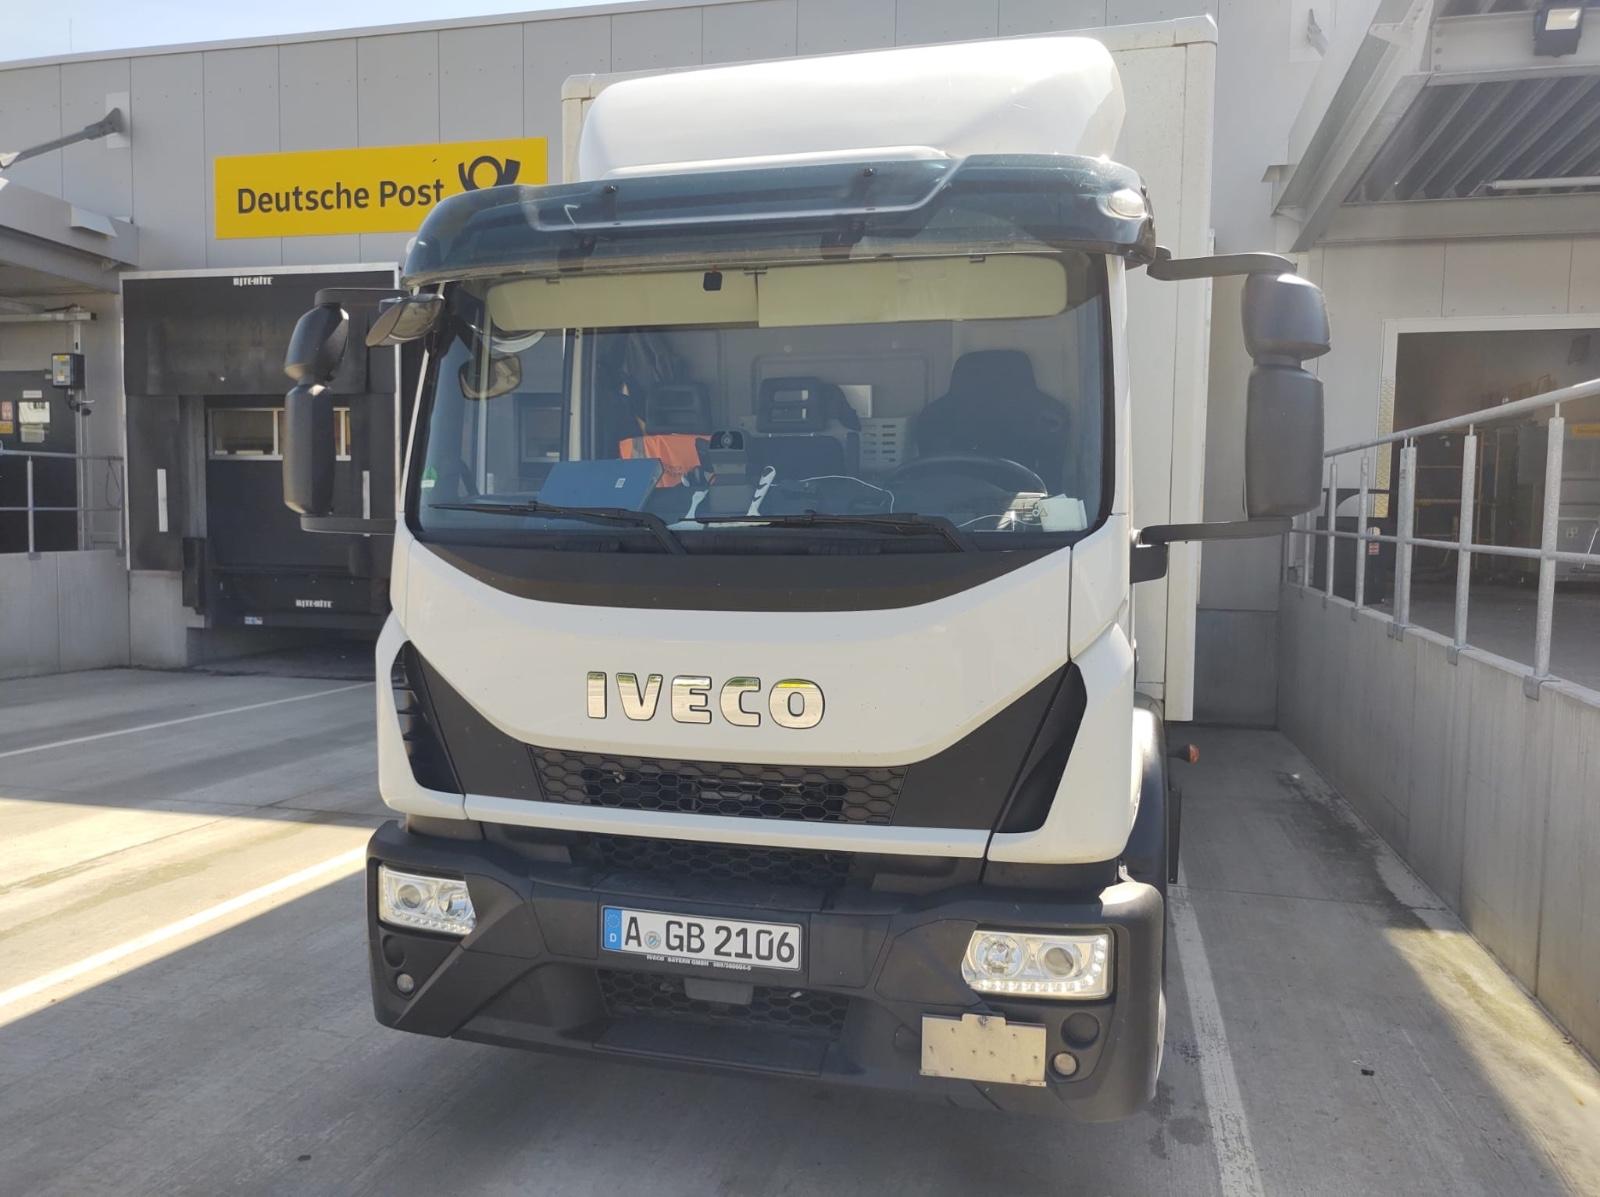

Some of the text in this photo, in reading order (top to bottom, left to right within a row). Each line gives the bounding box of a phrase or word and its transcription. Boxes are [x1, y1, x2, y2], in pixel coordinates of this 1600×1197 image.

[237, 179, 444, 214] Deutsche Post
[587, 671, 826, 729] IVECO
[609, 932, 617, 943] D
[624, 916, 795, 963] A GB 2106
